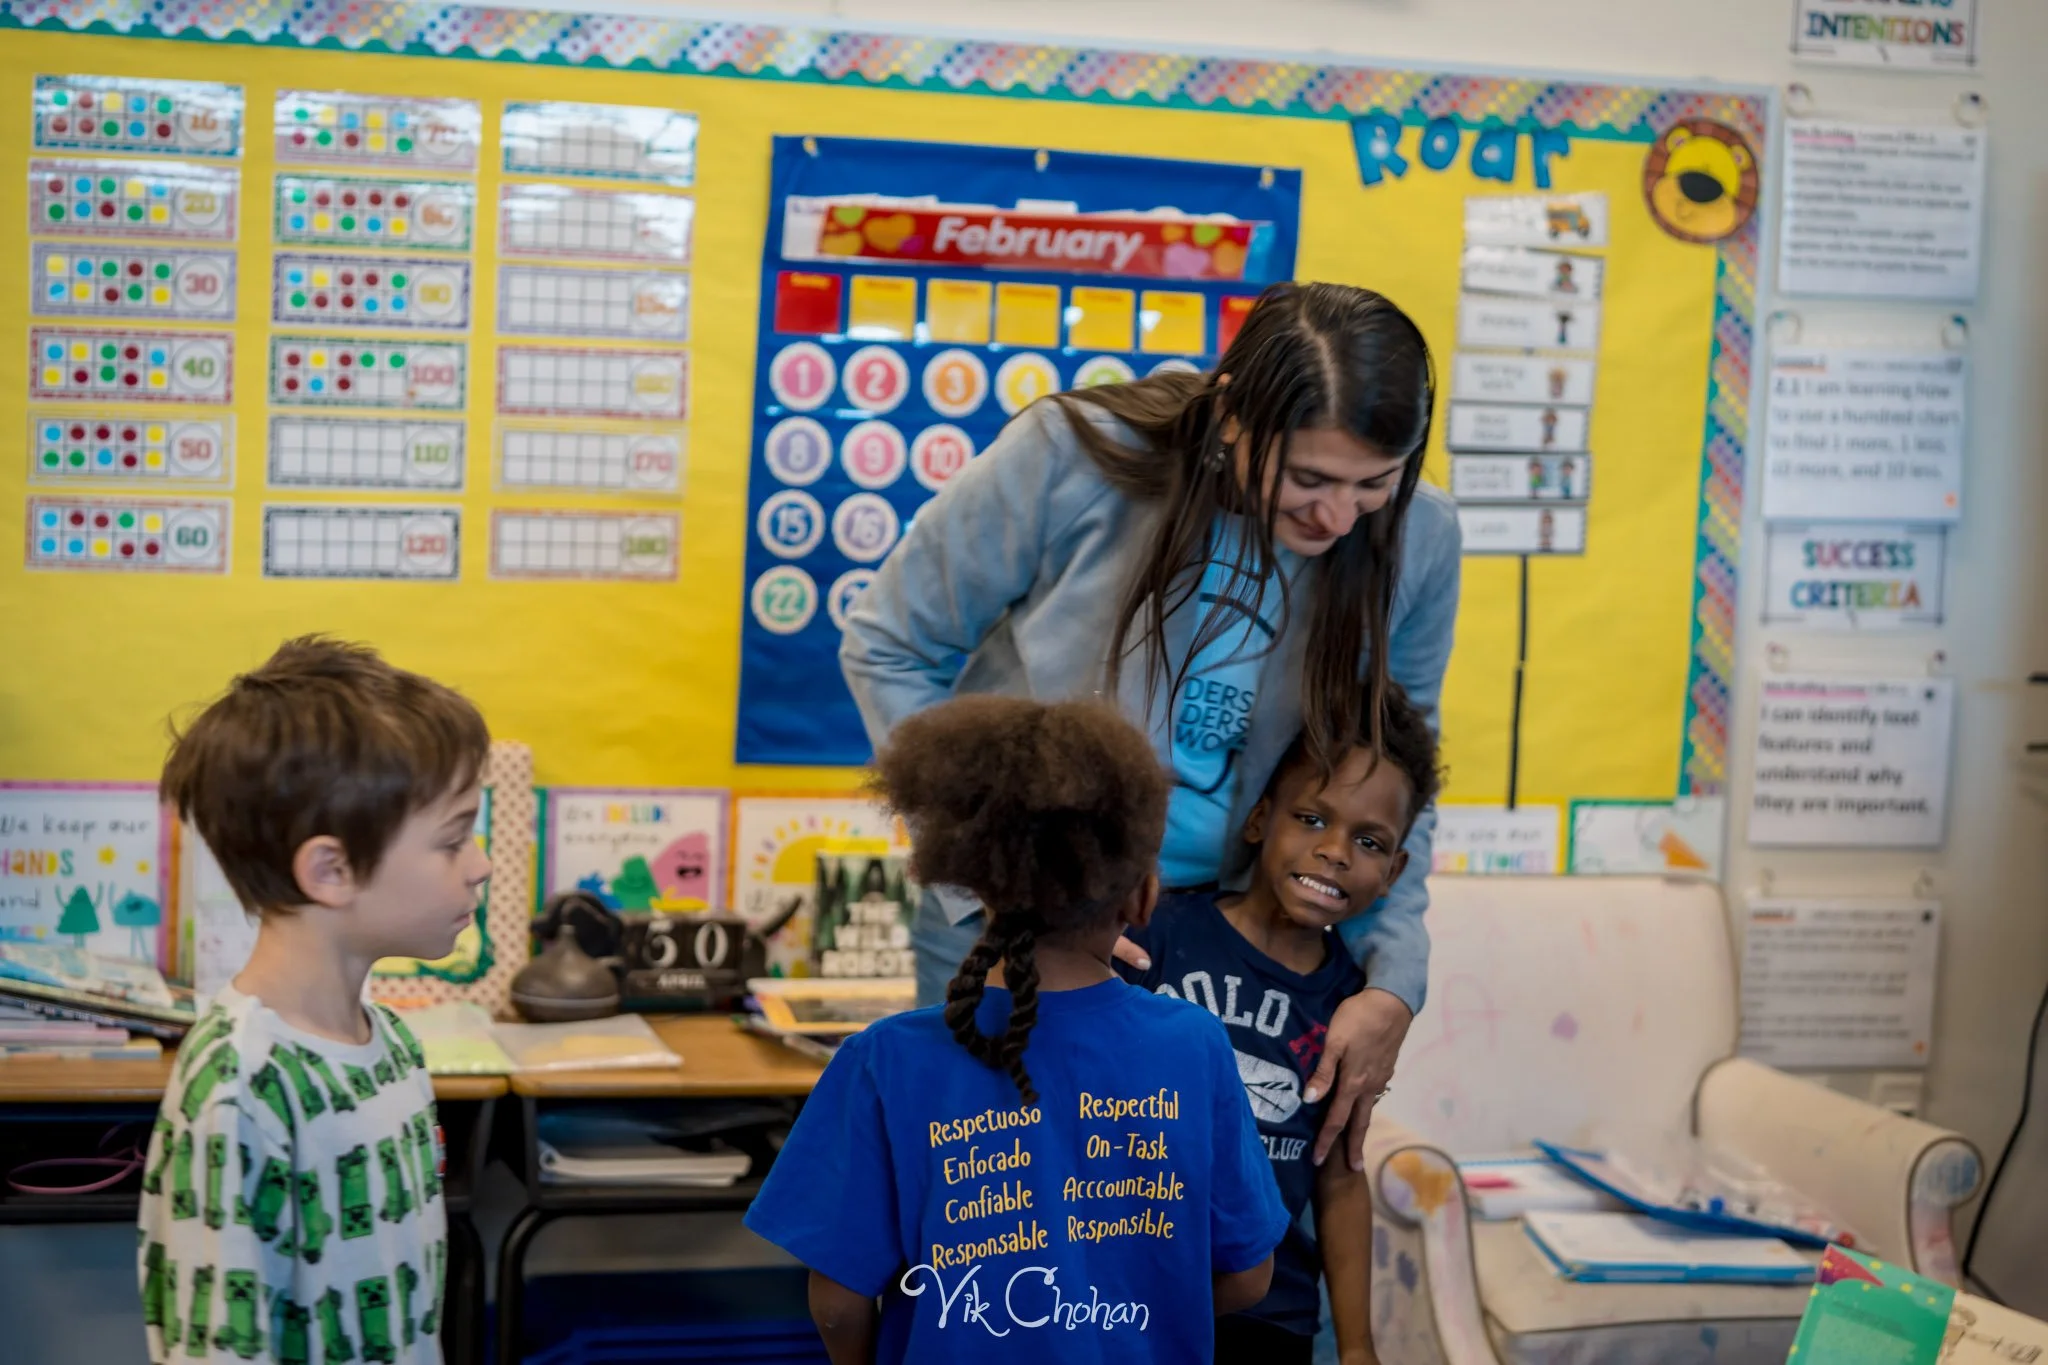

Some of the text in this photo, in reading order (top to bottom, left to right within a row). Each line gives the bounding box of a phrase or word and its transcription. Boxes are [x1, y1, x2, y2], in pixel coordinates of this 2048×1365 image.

[1805, 11, 1966, 46] INTENTIONS
[1350, 114, 1570, 190] Roar
[932, 215, 1145, 272] February
[185, 273, 219, 295] 30
[182, 356, 216, 378] 40
[409, 363, 457, 387] 100
[795, 362, 812, 394] 1
[865, 363, 887, 397] 2
[945, 365, 966, 400] 3
[1016, 371, 1039, 401] 4
[178, 437, 213, 461] 50
[412, 443, 450, 464] 110
[788, 431, 809, 467] 8
[863, 437, 885, 471] 9
[929, 441, 959, 477] 10
[175, 526, 209, 548] 60
[776, 506, 812, 543] 15
[848, 508, 886, 544] 16
[404, 534, 448, 558] 120
[1803, 540, 1917, 569] SUCCESS
[766, 583, 806, 618] 22
[1789, 580, 1922, 609] CRITERIA
[1771, 708, 1802, 721] can
[1807, 706, 1878, 727] identify
[1758, 732, 1873, 753] features and
[1756, 764, 1904, 786] understand why
[43, 812, 96, 842] keep
[108, 820, 149, 834] our
[1079, 1087, 1179, 1121] Respectful
[929, 1105, 1042, 1148] Respetuoso
[944, 1137, 1031, 1185] Enfocado
[945, 1179, 1034, 1224] Confiable
[1067, 1208, 1174, 1244] Responsible
[932, 1220, 1048, 1270] Responsable
